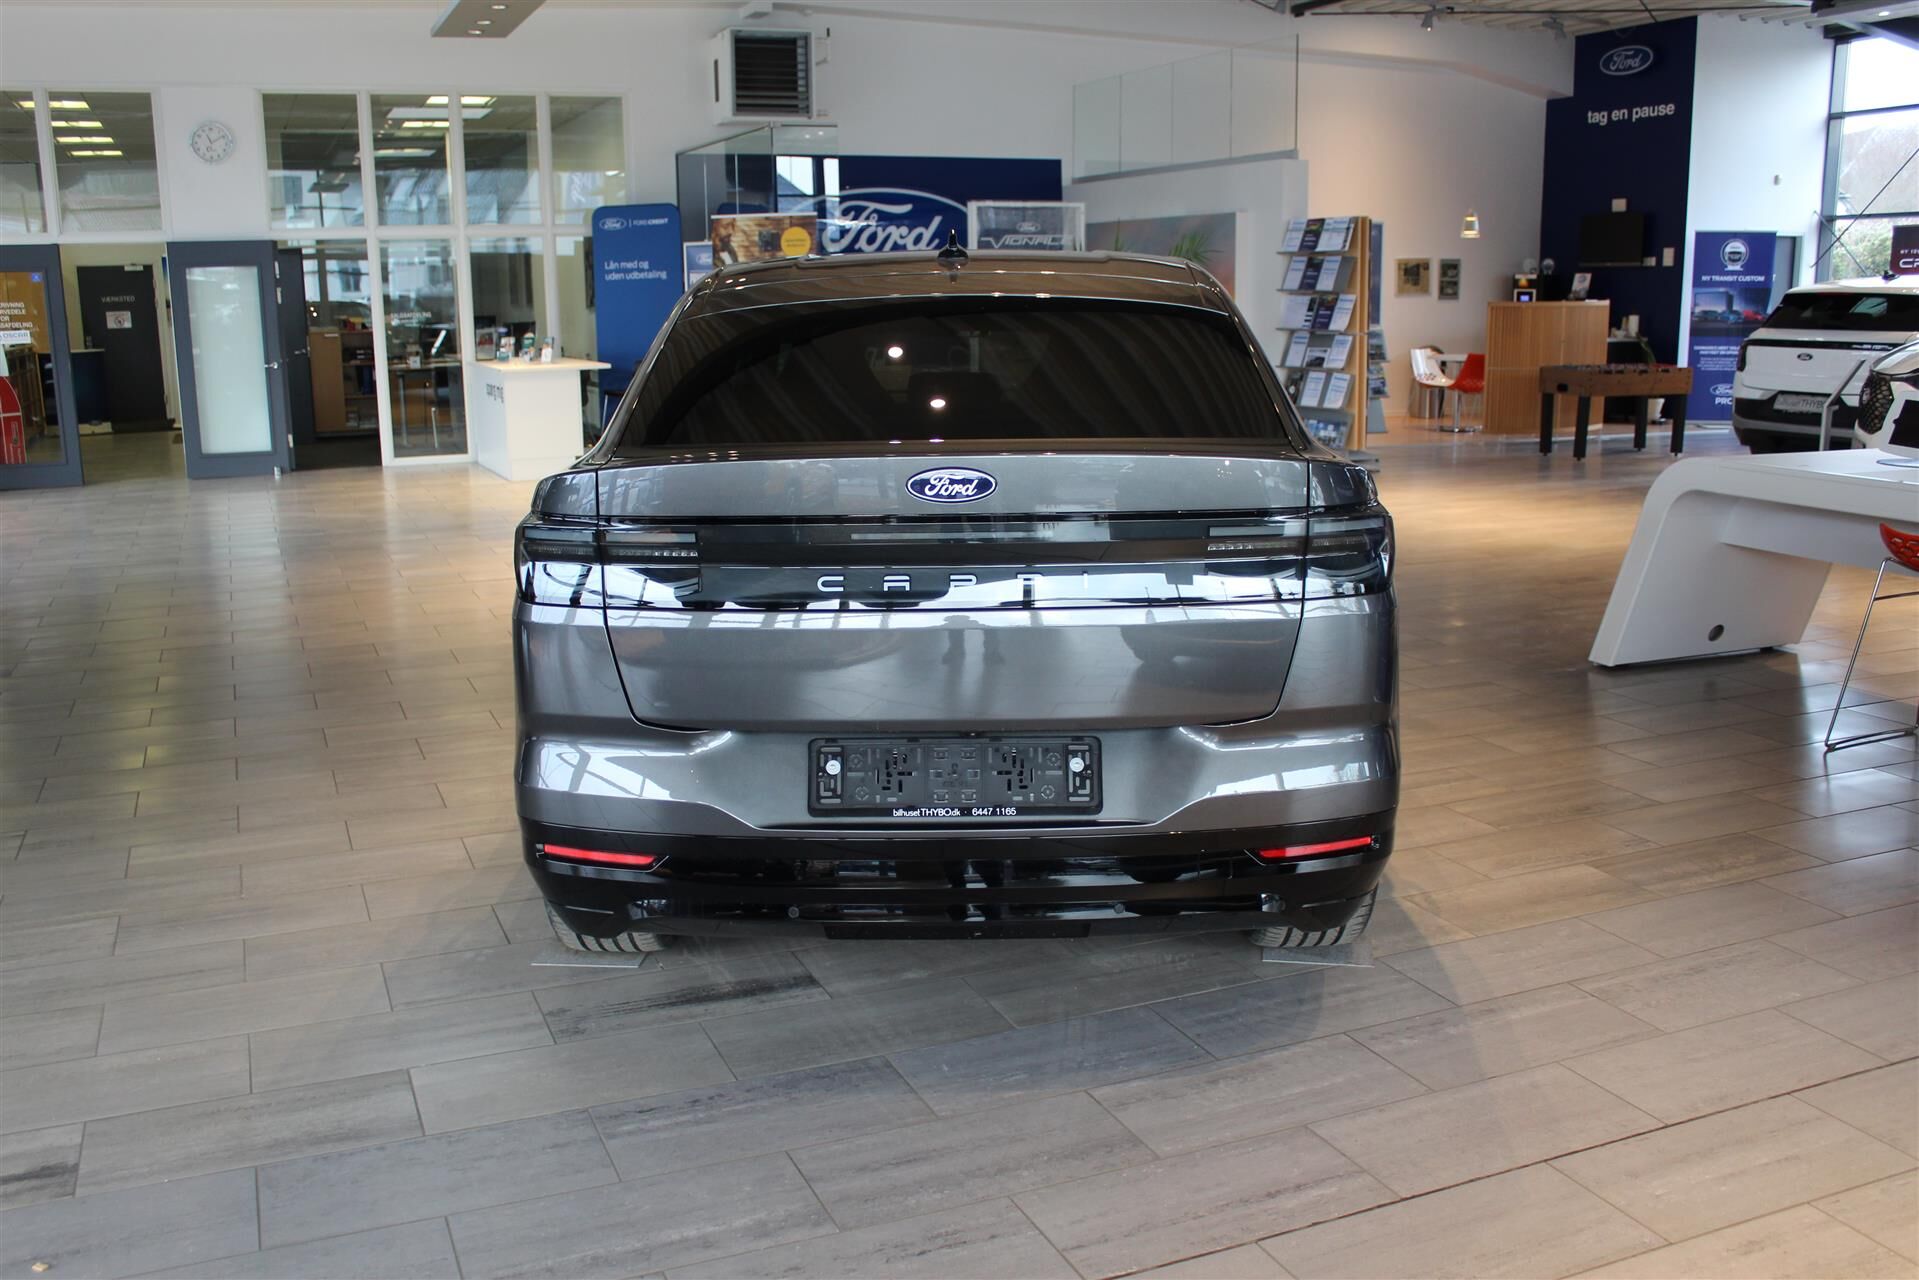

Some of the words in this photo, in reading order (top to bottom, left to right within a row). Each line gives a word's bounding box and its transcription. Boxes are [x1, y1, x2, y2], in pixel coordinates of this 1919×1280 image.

[1609, 50, 1642, 70] Ford
[1588, 109, 1608, 126] tag
[1611, 109, 1628, 121] en
[1632, 103, 1675, 122] pause
[822, 201, 943, 253] Ford
[604, 259, 620, 270] Lån
[620, 260, 638, 269] med
[638, 261, 649, 270] og
[604, 272, 625, 281] uden
[625, 270, 667, 280] udbetaling
[924, 473, 979, 497] Ford
[817, 571, 1088, 592] CAPRI
[972, 807, 993, 816] 6447
[996, 807, 1017, 816] 1165
